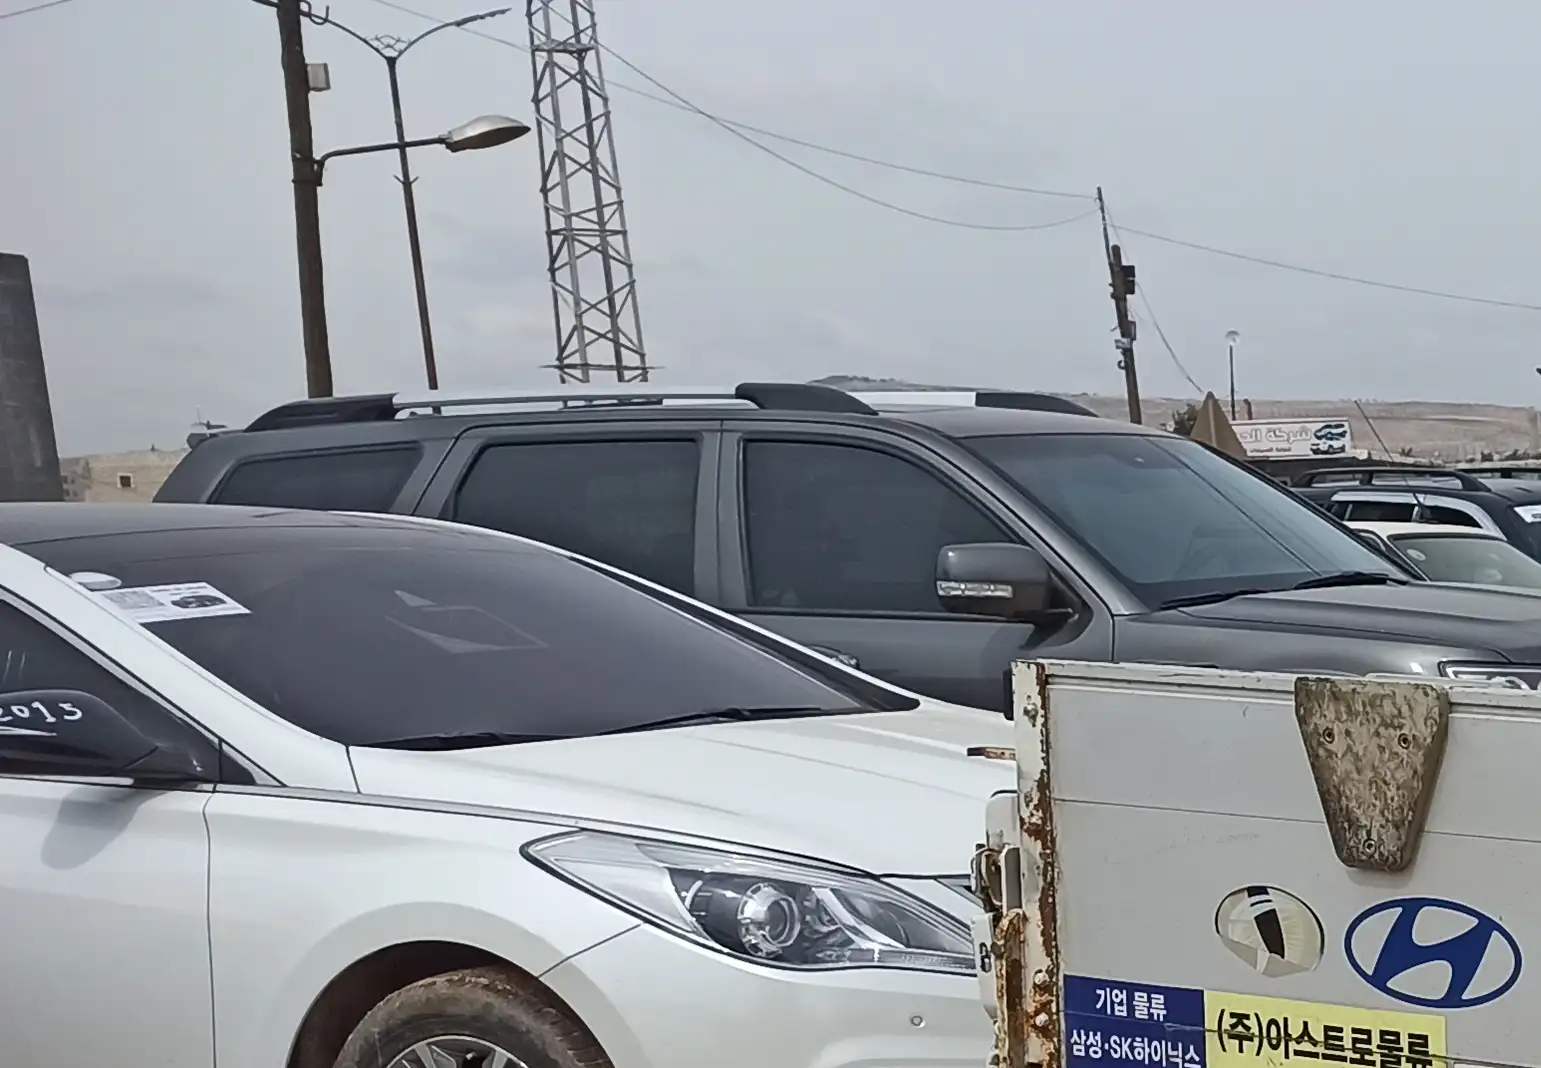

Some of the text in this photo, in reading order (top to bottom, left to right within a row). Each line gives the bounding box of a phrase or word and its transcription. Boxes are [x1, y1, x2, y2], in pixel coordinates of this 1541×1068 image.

[1266, 426, 1312, 444] شركة
[1095, 988, 1167, 1022] 기업 물류
